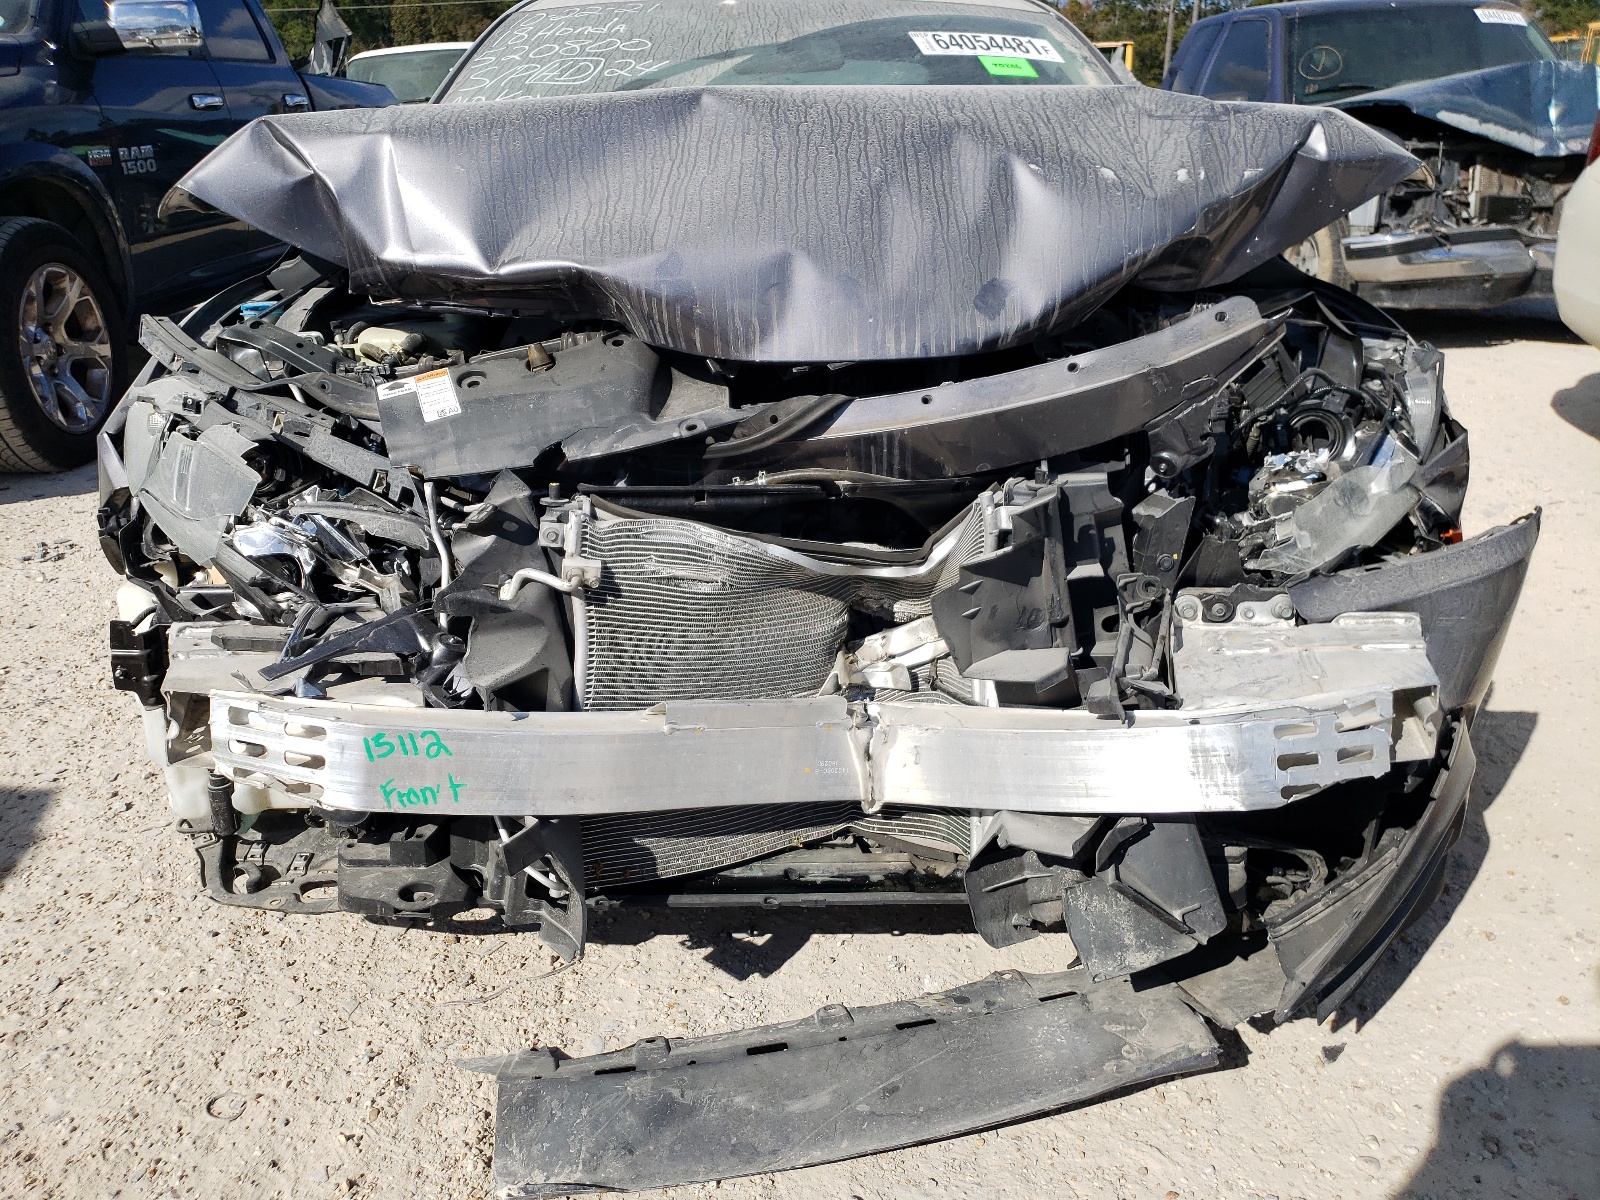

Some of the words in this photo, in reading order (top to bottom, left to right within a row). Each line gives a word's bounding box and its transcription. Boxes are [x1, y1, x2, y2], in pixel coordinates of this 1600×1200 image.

[492, 26, 534, 48] 18
[931, 33, 1043, 56] 64054481
[471, 38, 653, 69] 520800
[118, 145, 155, 162] RAM
[121, 158, 157, 175] 1500
[363, 729, 453, 763] 15112
